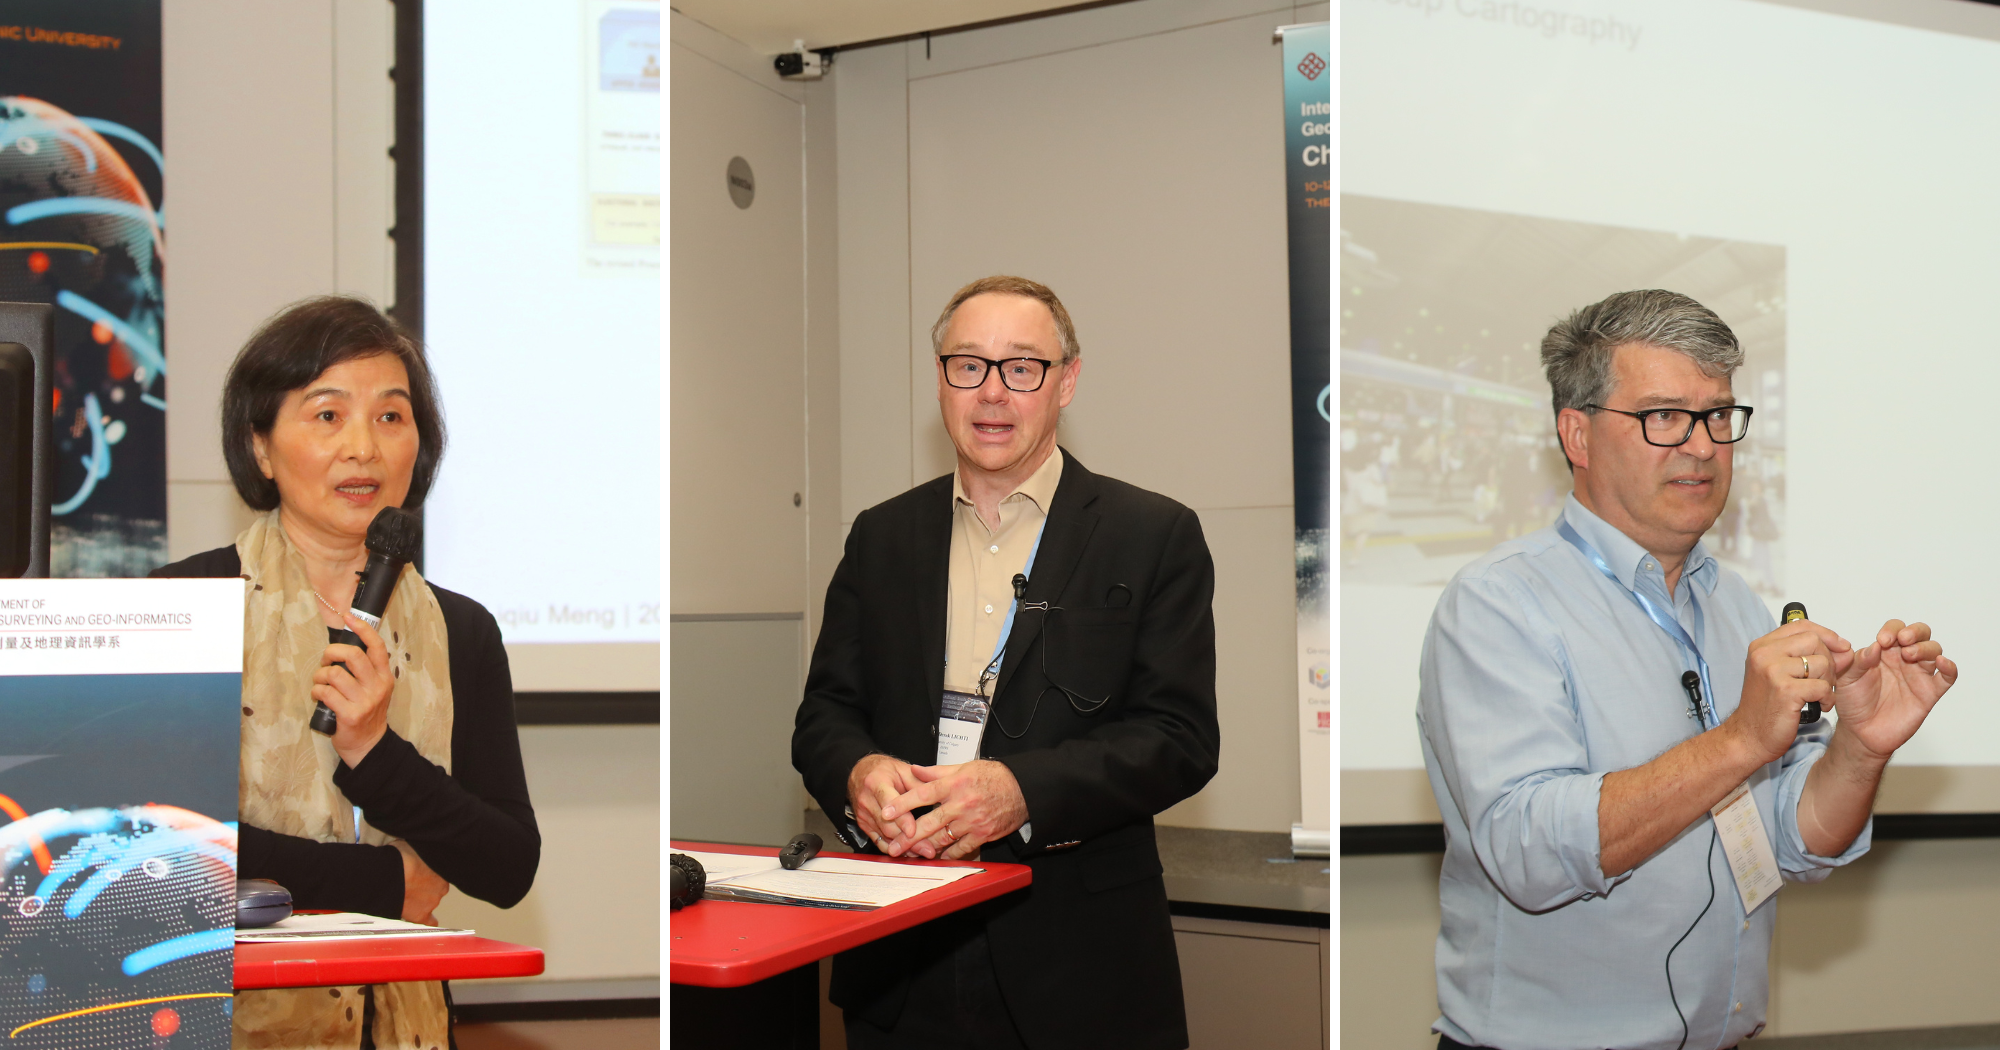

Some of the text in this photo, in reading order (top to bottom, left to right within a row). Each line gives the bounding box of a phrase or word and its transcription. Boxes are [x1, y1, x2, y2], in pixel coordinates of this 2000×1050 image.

[1455, 0, 1643, 52] Cartography
[25, 27, 122, 49] UNIVERSITY
[1, 599, 45, 609] MENT OF
[0, 613, 192, 626] SURVEYING AND GEO-INFORMATICS
[547, 604, 616, 630] Meng
[0, 636, 121, 649] 量及地理資訊學系
